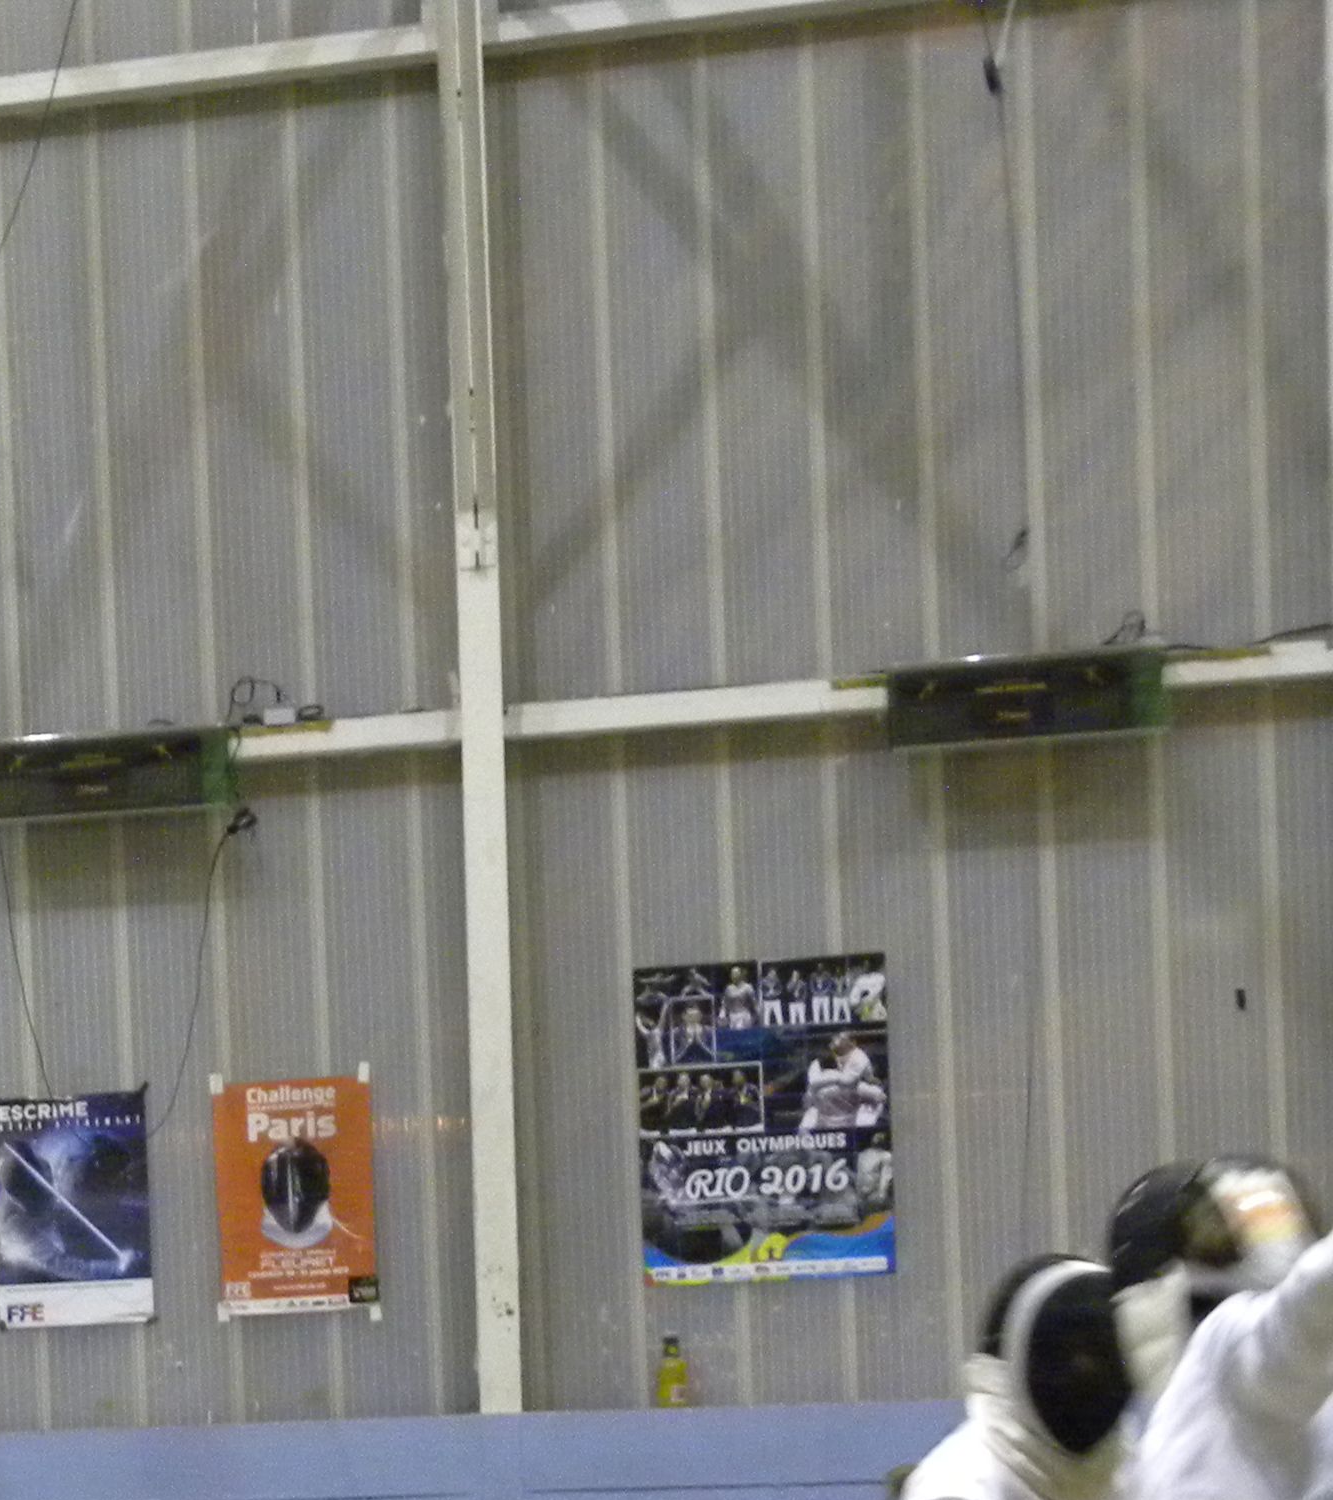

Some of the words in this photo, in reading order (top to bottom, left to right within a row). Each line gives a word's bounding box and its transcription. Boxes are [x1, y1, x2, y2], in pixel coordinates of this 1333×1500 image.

[245, 1085, 336, 1105] Challenge
[247, 1110, 337, 1141] Paris
[684, 1140, 726, 1156] JEUX
[736, 1132, 847, 1153] OLYMPIQUES
[685, 1166, 750, 1199] RIO
[759, 1158, 849, 1195] 2016
[7, 1302, 44, 1323] FFE
